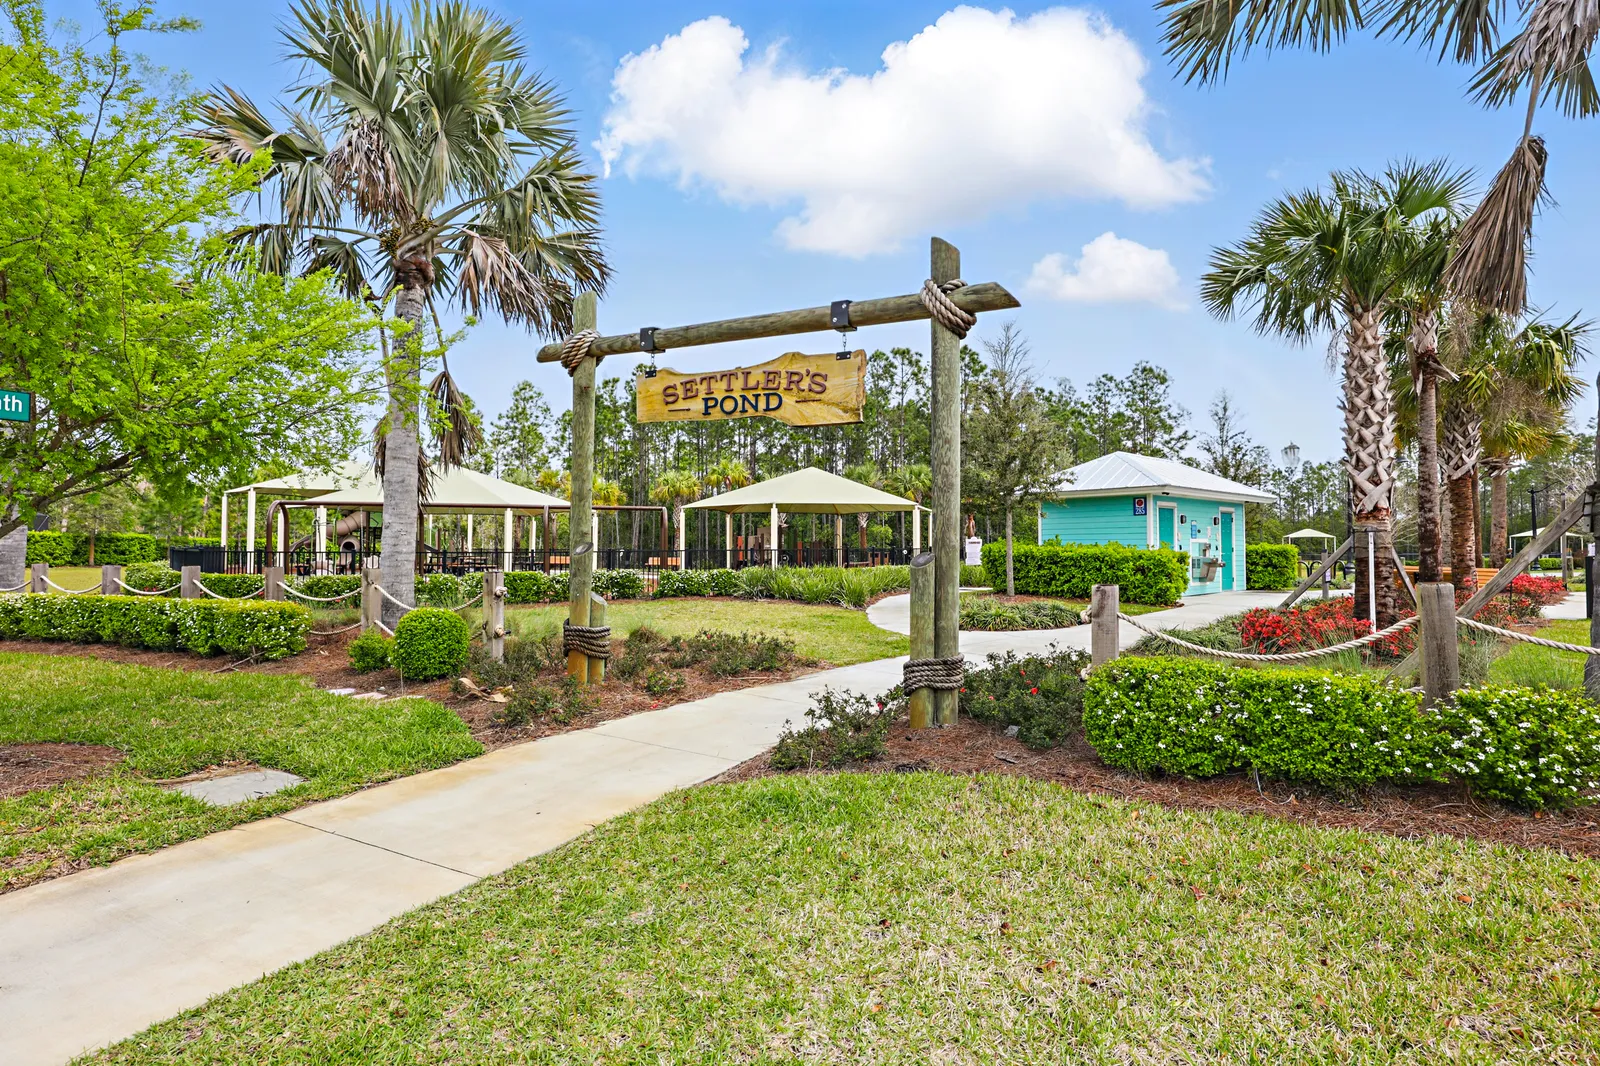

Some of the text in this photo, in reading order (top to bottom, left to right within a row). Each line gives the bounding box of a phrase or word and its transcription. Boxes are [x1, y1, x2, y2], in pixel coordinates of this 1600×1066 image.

[662, 368, 828, 405] SETTLER'S
[0, 394, 22, 413] th
[701, 392, 783, 416] POND
